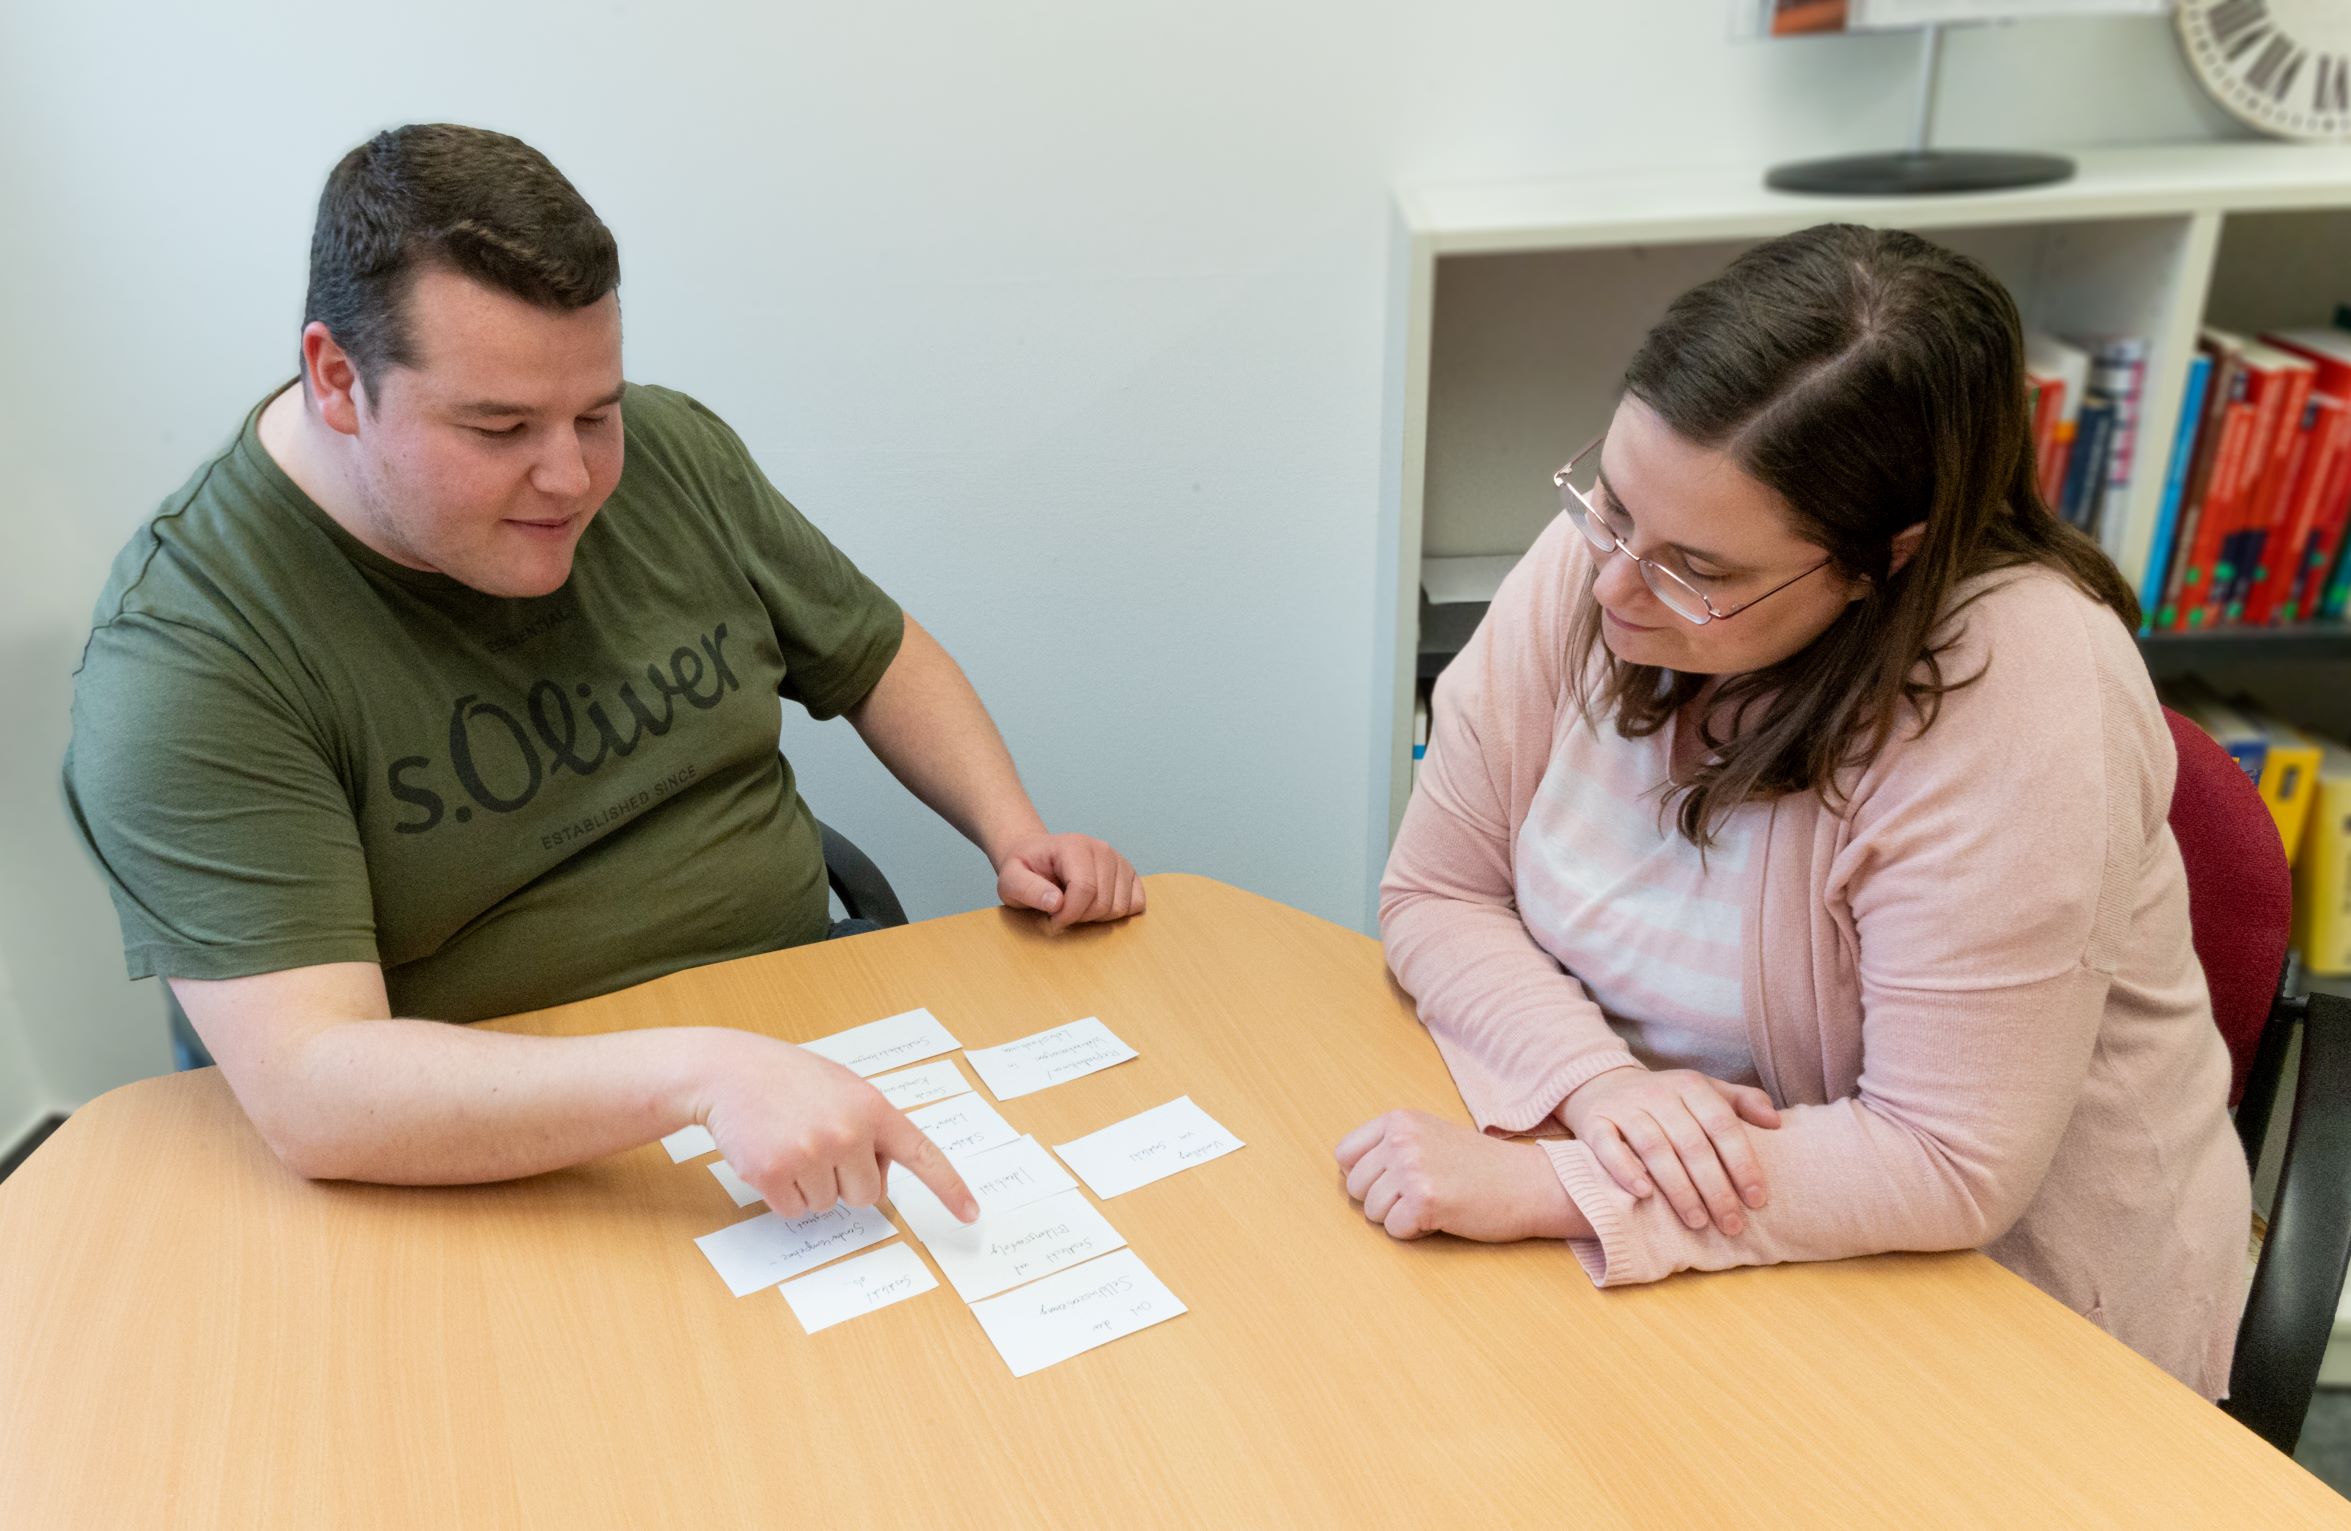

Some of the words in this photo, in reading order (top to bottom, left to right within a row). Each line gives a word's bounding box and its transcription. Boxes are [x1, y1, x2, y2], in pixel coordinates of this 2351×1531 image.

[387, 622, 740, 834] s.Oliver
[541, 791, 649, 851] ESTABLISHED
[655, 764, 698, 803] SINCE
[991, 1223, 1070, 1257] Bildungserfolg
